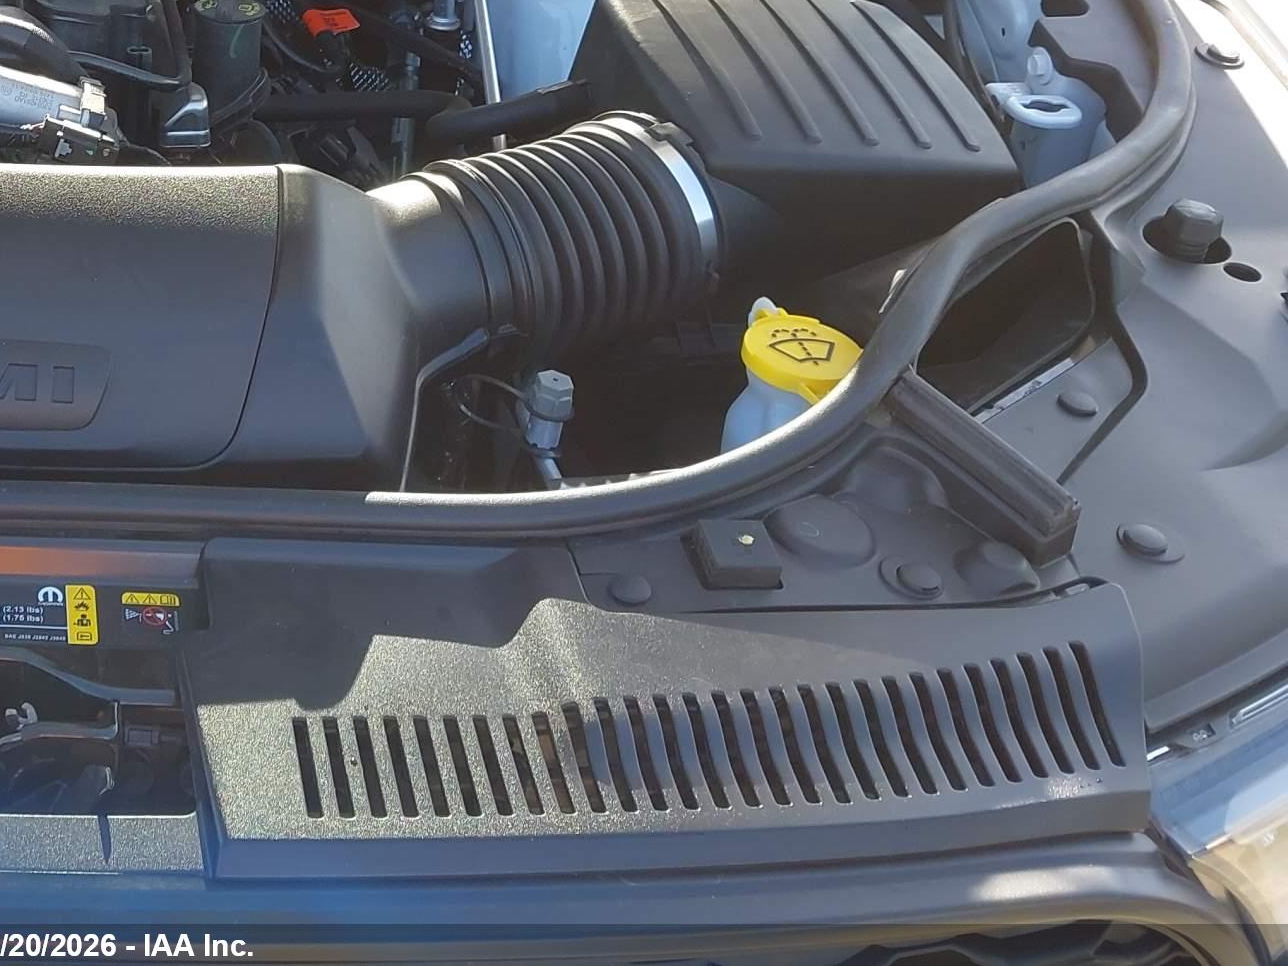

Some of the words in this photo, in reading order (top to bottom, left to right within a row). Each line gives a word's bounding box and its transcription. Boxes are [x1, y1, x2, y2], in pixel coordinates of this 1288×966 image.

[3, 605, 25, 614] (2.13
[26, 606, 44, 615] lbs)
[26, 614, 44, 623] lbs)
